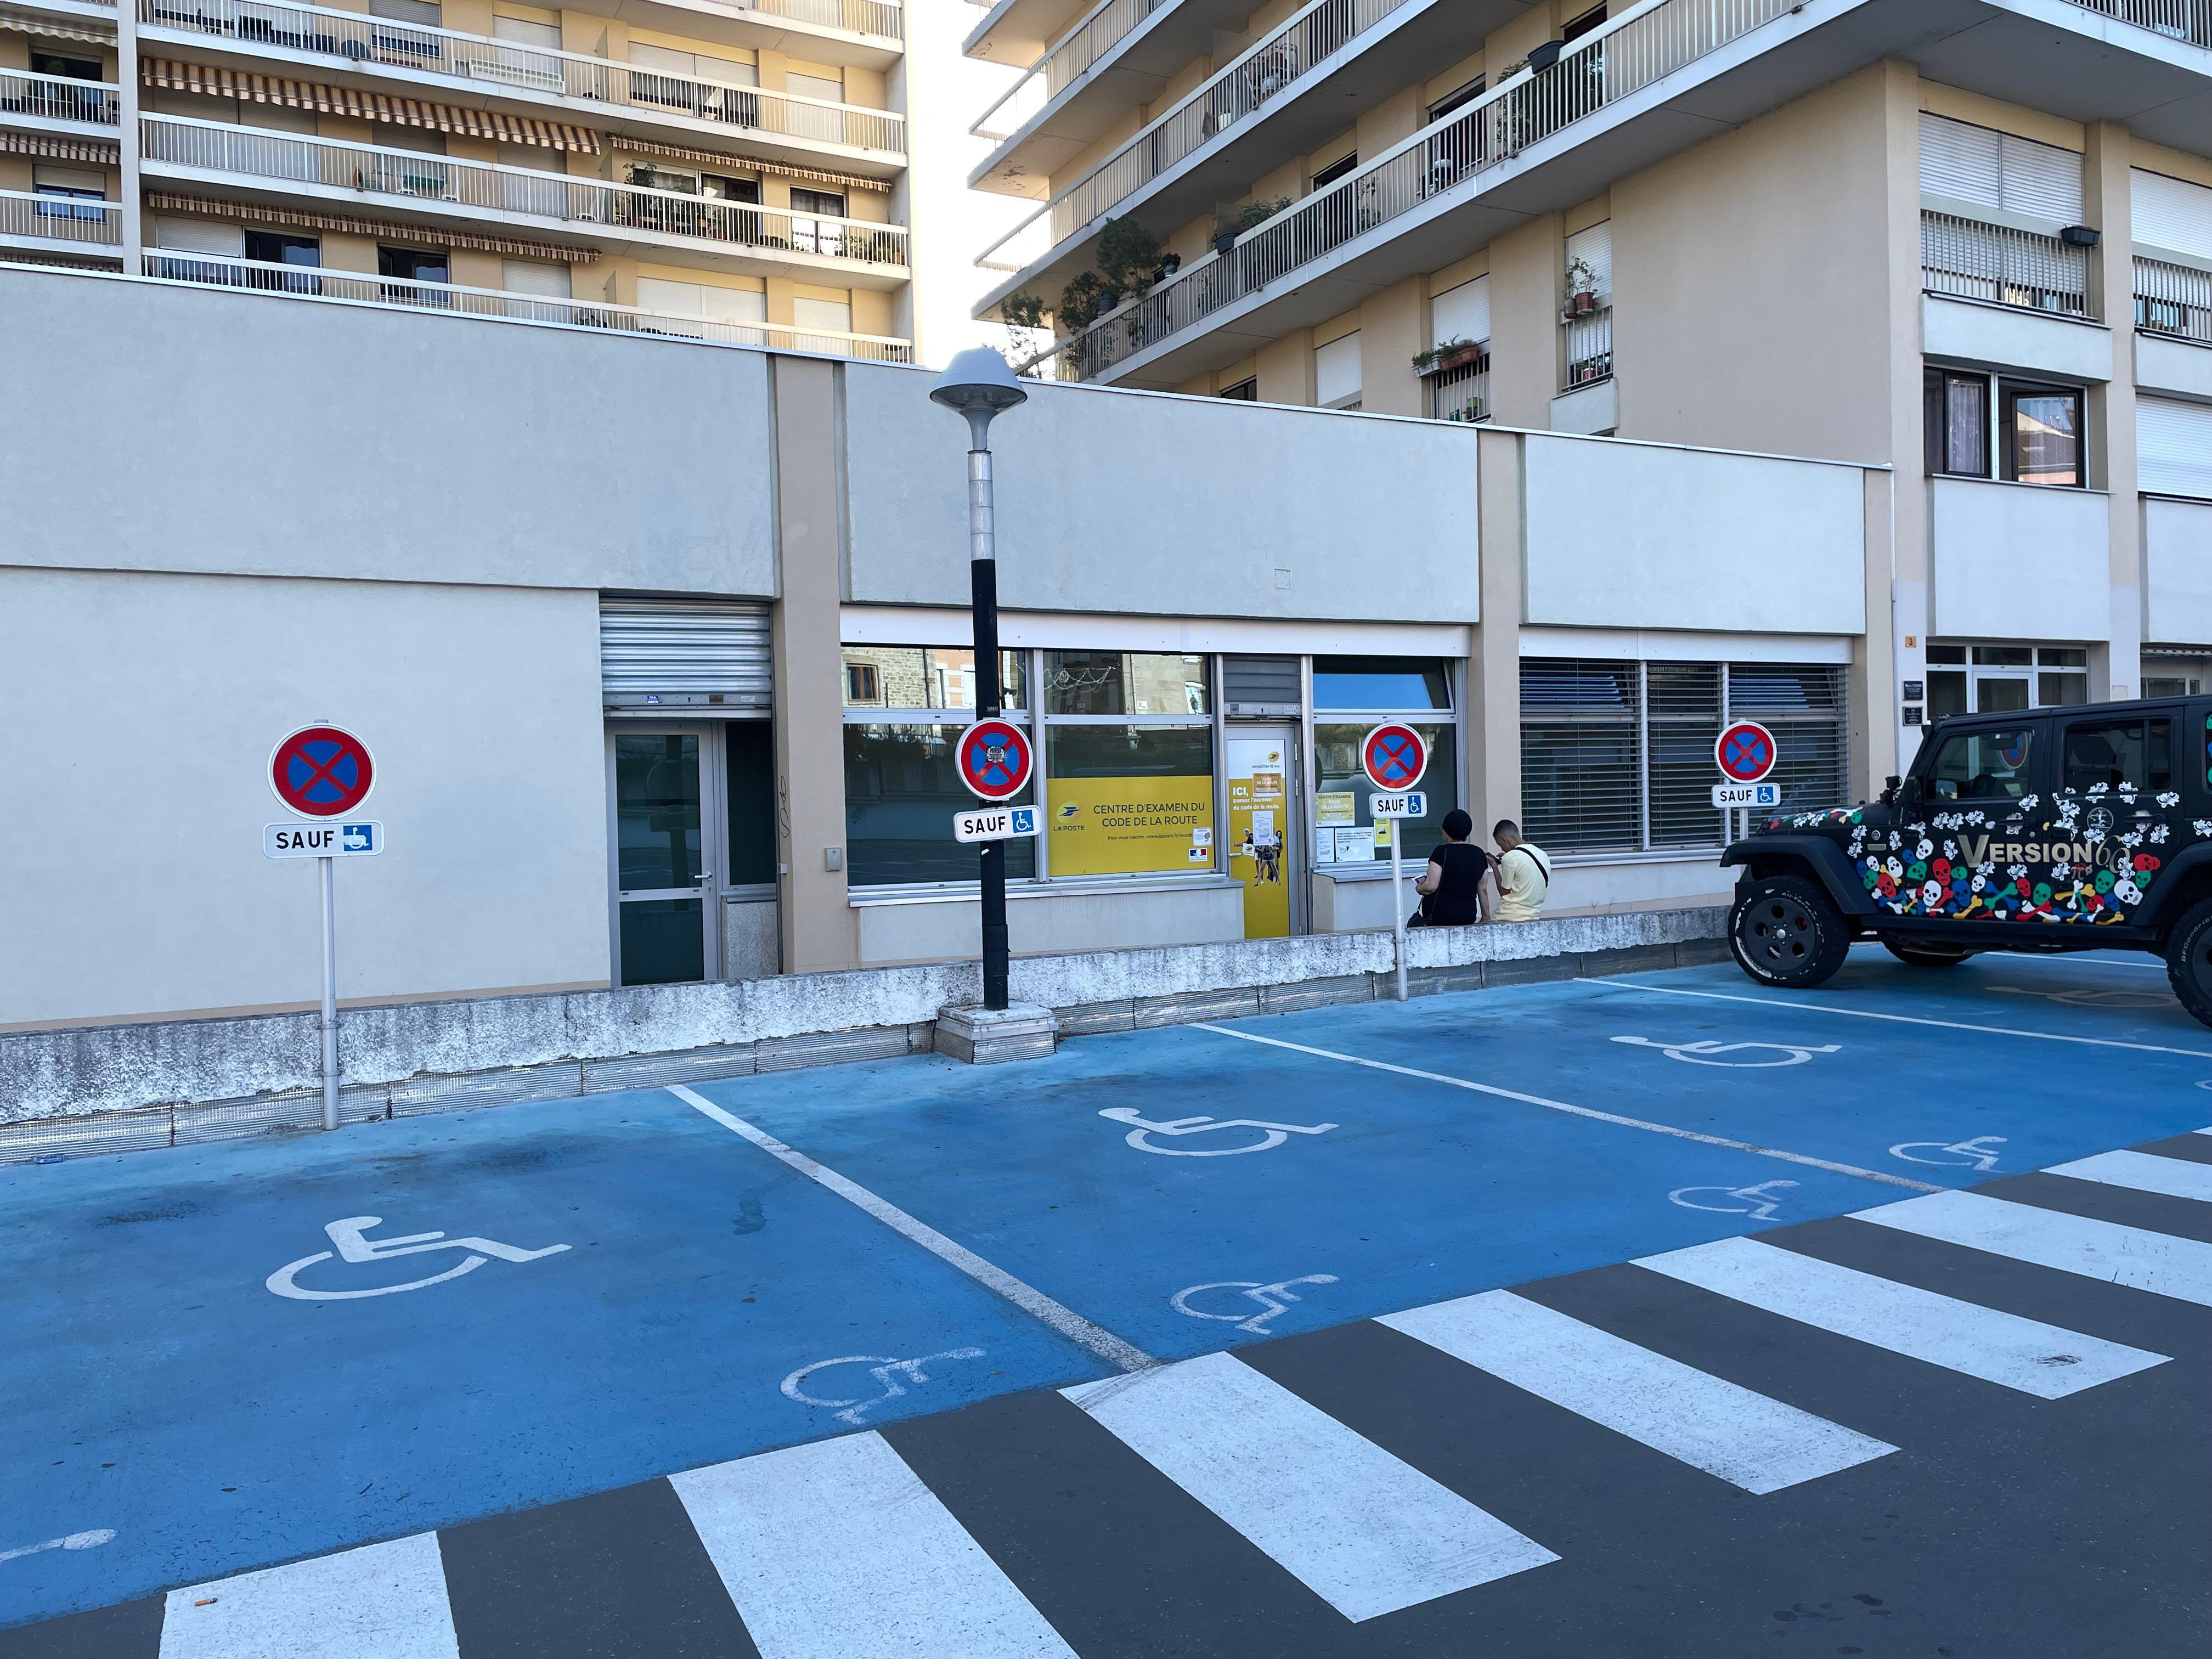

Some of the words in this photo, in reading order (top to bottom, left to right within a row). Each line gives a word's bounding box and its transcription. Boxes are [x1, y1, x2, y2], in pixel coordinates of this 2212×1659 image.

[1909, 637, 1913, 646] 3
[1233, 787, 1249, 797] ICI,
[1720, 790, 1752, 802] SAUF
[1093, 804, 1134, 814] CENTRE
[1137, 803, 1188, 813] D'EXAMEN
[1191, 803, 1205, 811] DU
[1378, 799, 1404, 812] SAUF
[964, 816, 1006, 834] SAUF
[1102, 817, 1131, 827] CODE
[1133, 817, 1147, 826] DE
[1150, 816, 1163, 825] LA
[1164, 815, 1198, 825] ROUTE
[276, 830, 334, 849] SAUF
